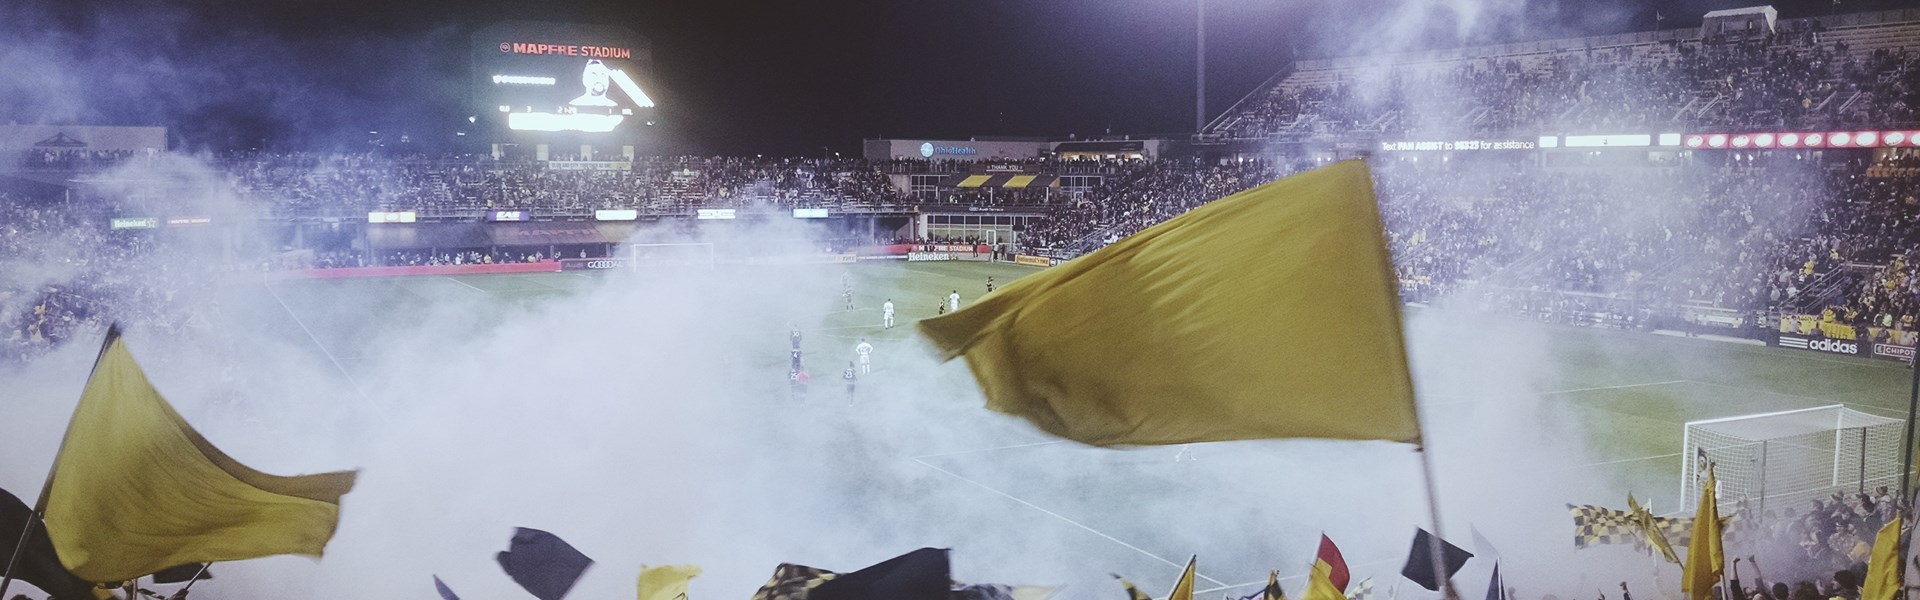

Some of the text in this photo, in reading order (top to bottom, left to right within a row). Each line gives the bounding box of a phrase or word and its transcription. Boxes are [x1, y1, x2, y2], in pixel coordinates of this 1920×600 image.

[513, 43, 631, 59] MAPFRE STADIUM
[935, 146, 976, 155] OhioHealth
[1382, 142, 1397, 151] Text
[1397, 141, 1414, 151] FAN
[1415, 141, 1443, 151] ASSIST
[1445, 142, 1453, 151] to
[1480, 140, 1492, 150] for
[1493, 140, 1534, 150] assistance
[908, 252, 949, 261] Heineken
[1809, 338, 1858, 354] adidas
